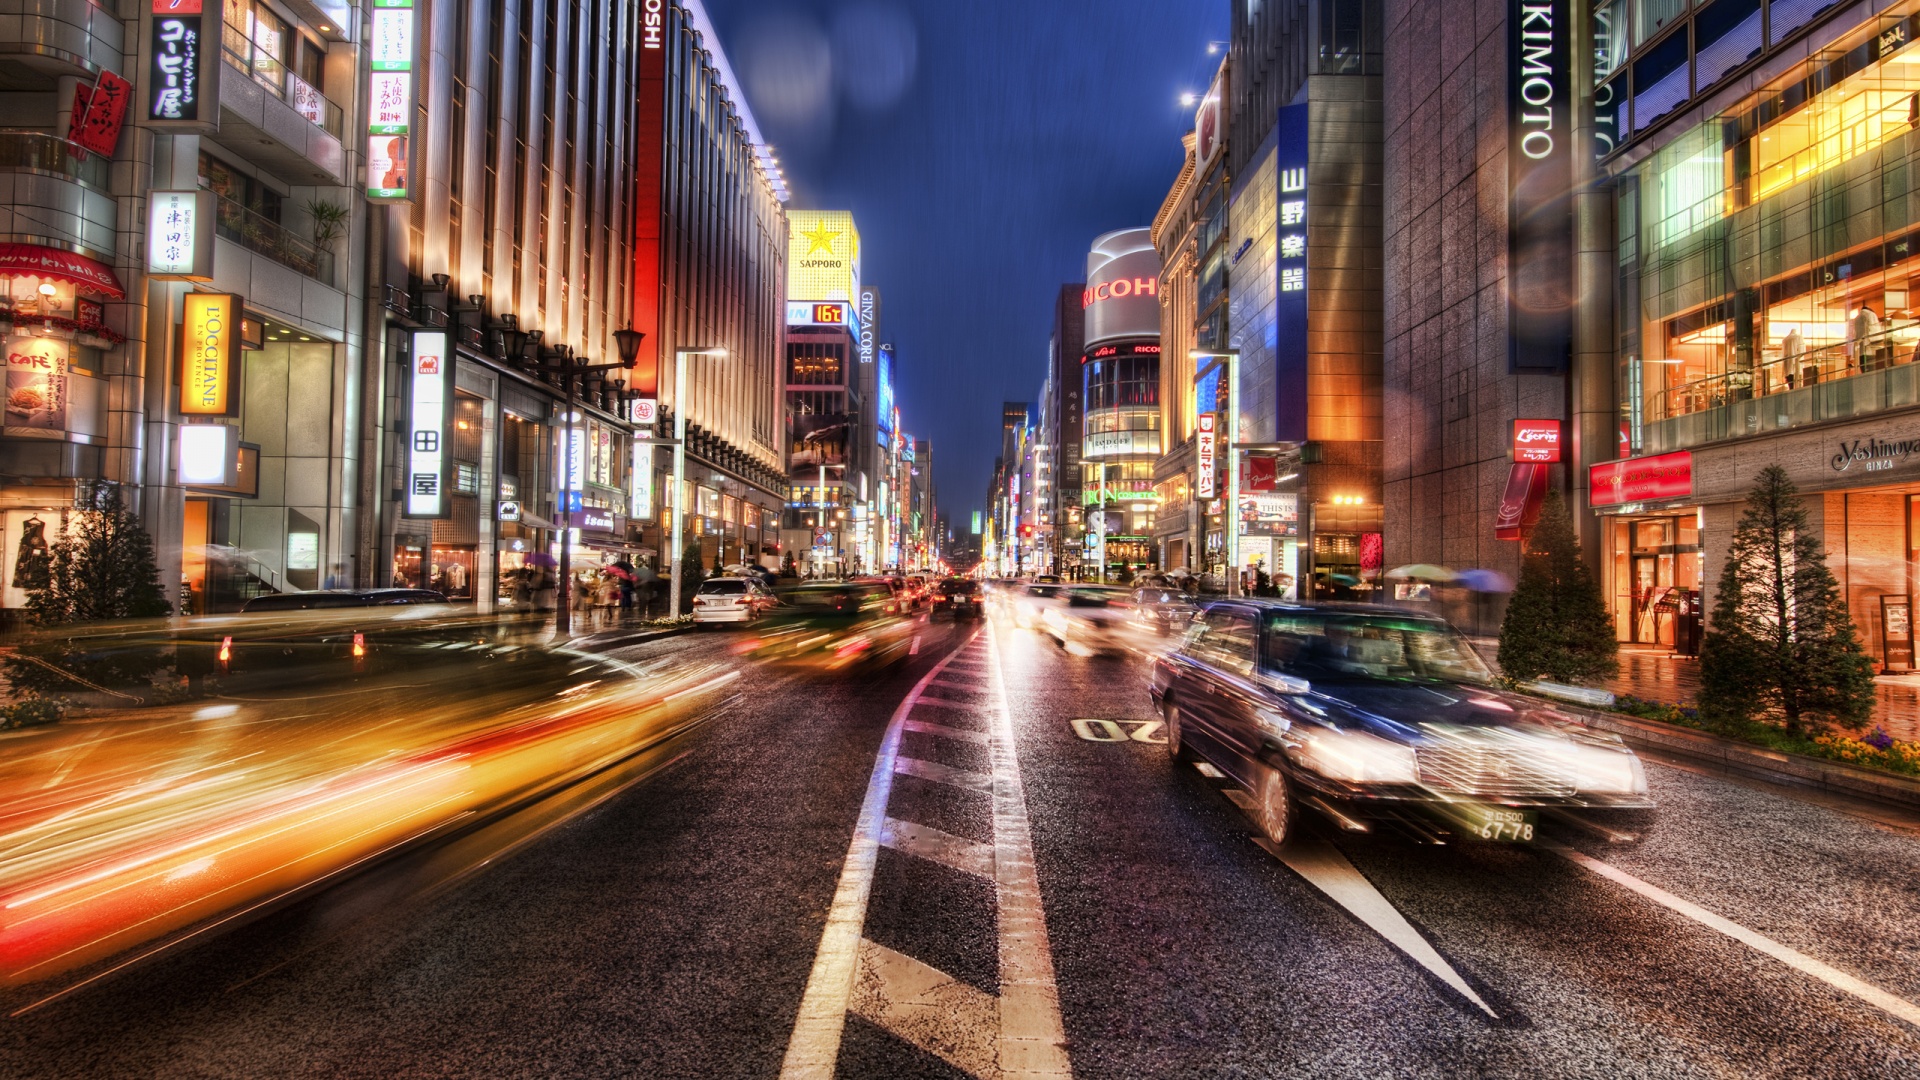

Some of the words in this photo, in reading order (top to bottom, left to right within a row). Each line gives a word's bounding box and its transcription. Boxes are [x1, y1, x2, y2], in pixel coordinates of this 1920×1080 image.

[645, 0, 661, 48] OSHI
[154, 20, 185, 118] コーヒー屋
[380, 80, 391, 109] すみか
[392, 76, 402, 105] 天使の
[382, 125, 399, 133] 4F
[1281, 168, 1305, 292] 山野楽器
[799, 260, 842, 268] SAPPORO
[1082, 278, 1156, 310] RICOH
[861, 292, 874, 329] GINZA
[197, 324, 203, 336] EN
[202, 306, 222, 407] L'OCCITANE
[860, 330, 873, 364] CORE
[194, 340, 202, 389] PROVENCE
[1068, 391, 1078, 423] 鳩居堂
[412, 430, 439, 496] 田屋
[1201, 436, 1213, 494] キムラヤのパン
[1832, 438, 1920, 471] Yoshinoya
[1866, 459, 1893, 472] GINZA
[1251, 473, 1275, 487] Fender
[1652, 465, 1688, 479] Shop
[1118, 491, 1158, 499] COSMETICS
[1261, 504, 1283, 512] THIS
[1482, 821, 1534, 841] 67-78
